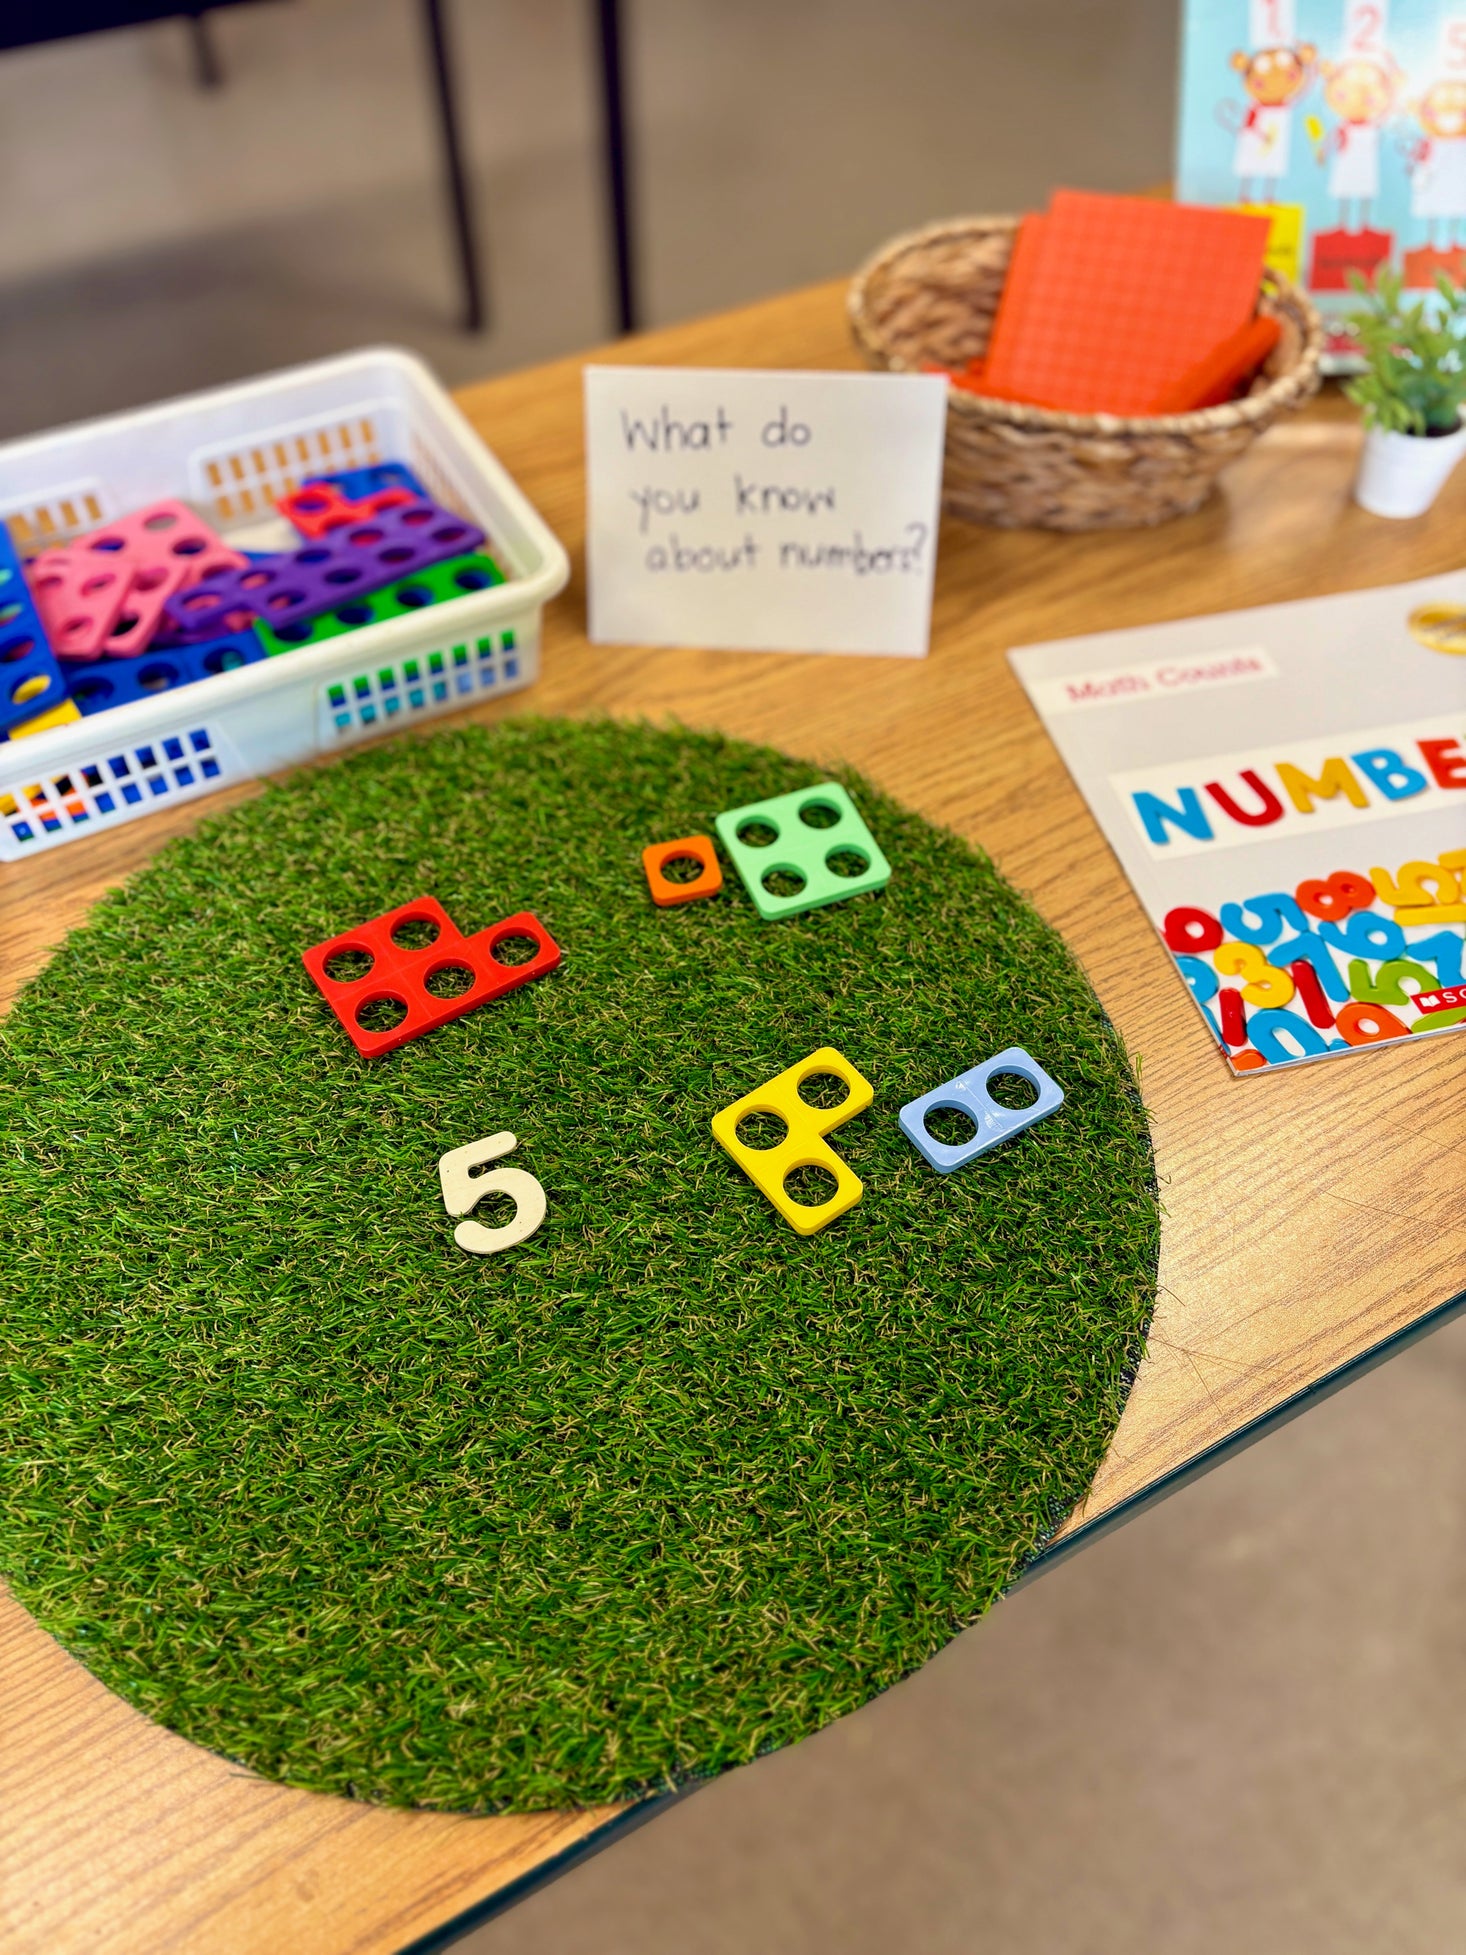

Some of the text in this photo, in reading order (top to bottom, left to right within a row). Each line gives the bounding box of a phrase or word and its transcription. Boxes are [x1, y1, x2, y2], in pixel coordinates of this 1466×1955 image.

[1351, 3, 1382, 52] 2
[620, 403, 812, 451] What do
[629, 472, 837, 535] you know
[645, 532, 758, 574] about
[1065, 675, 1150, 703] Math
[1131, 738, 1466, 845] NUMBE
[438, 1130, 547, 1255] 5
